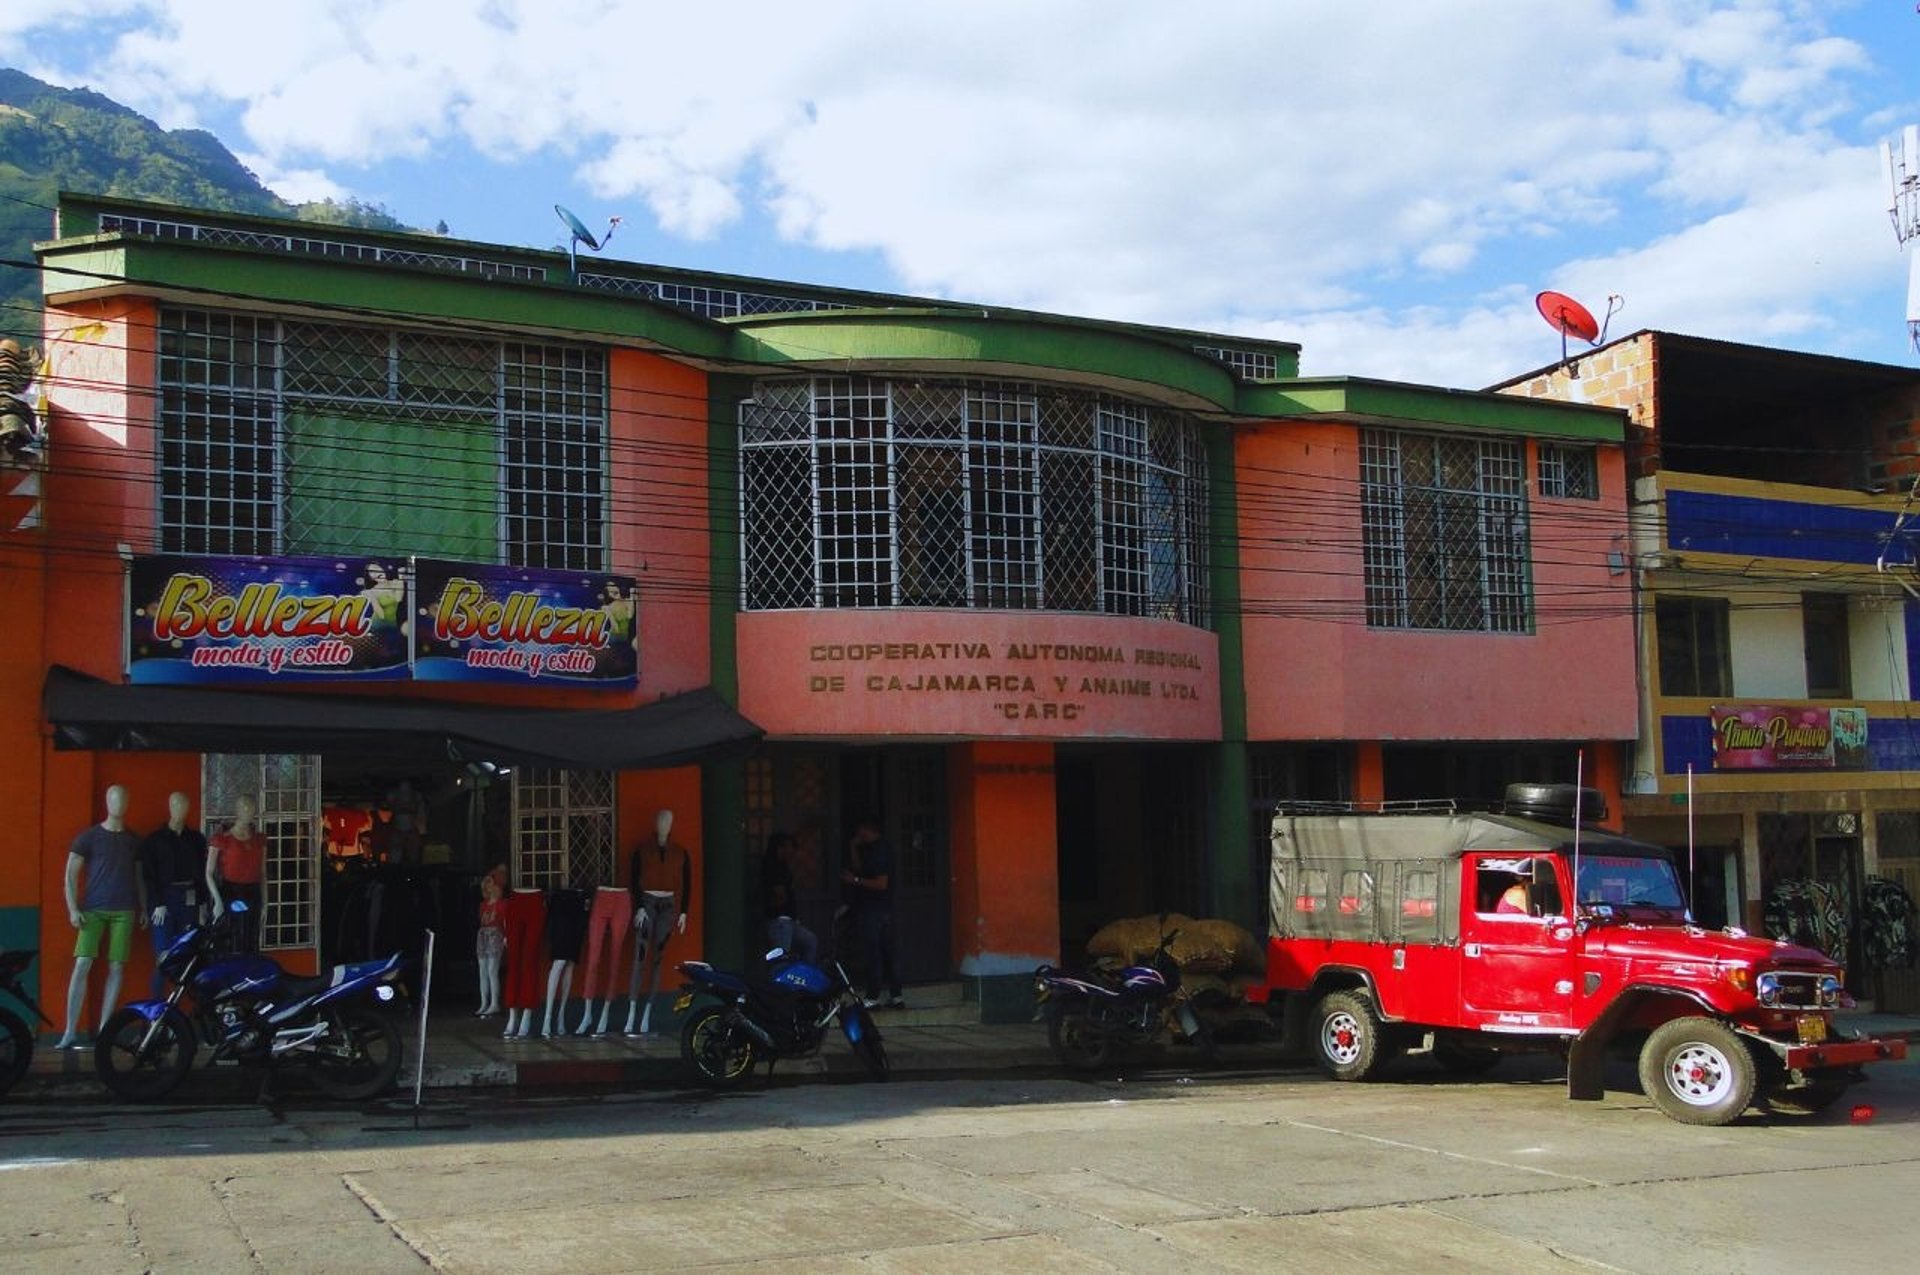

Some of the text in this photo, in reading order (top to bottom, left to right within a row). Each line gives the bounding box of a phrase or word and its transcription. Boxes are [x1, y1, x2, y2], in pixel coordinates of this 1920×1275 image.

[155, 574, 373, 640] Belleza
[436, 578, 609, 649] Belleza
[193, 640, 353, 673] moda y estilo
[468, 647, 597, 677] moda y estilo
[810, 643, 1201, 669] COOPERATIVA AUTONOMA REGIONAL
[811, 676, 845, 692] DE
[867, 675, 1036, 692] CAJAMARCA
[1054, 676, 1067, 692] Y
[1079, 677, 1151, 696] ANAIME
